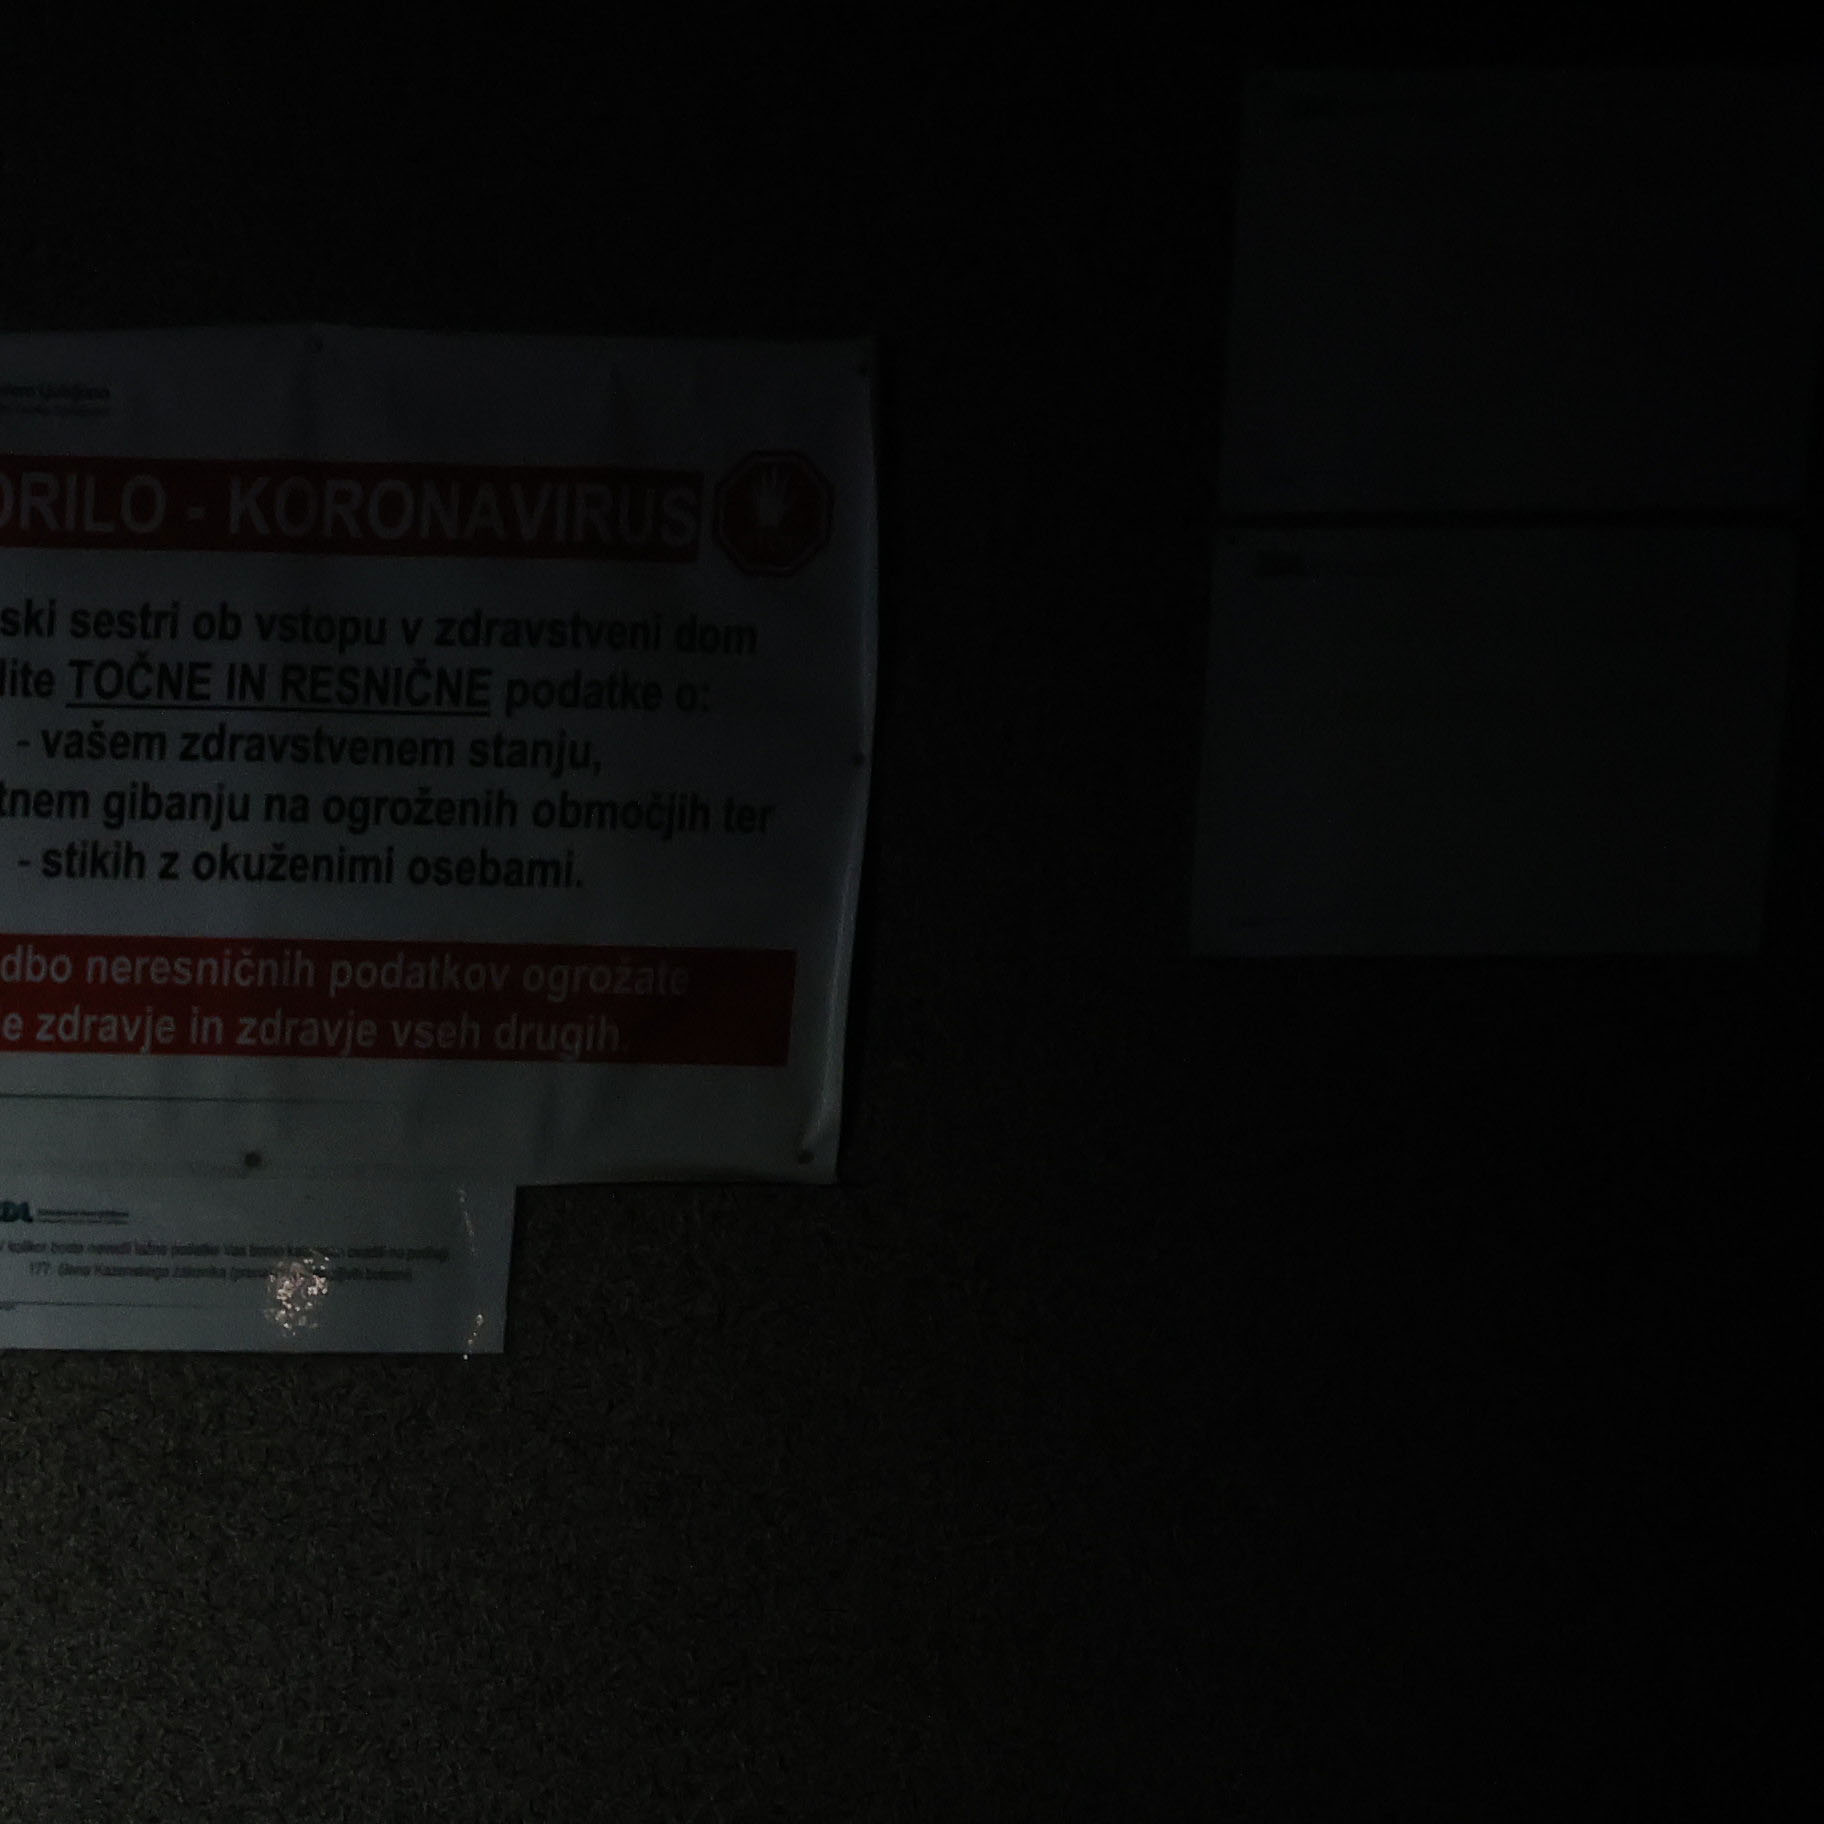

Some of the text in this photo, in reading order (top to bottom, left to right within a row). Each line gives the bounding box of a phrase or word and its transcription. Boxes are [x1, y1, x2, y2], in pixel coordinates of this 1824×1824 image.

[228, 474, 699, 549] KORONAVIRUS
[70, 601, 179, 639] sestri
[194, 603, 242, 641] ob
[256, 606, 386, 654] vstopu
[402, 620, 423, 645] v
[435, 609, 662, 652] zdravstveni
[675, 614, 758, 655] dom
[68, 650, 211, 701] TOČNE
[227, 662, 265, 702] IN
[281, 656, 493, 707] RESNIČNE
[506, 671, 662, 714] podatke
[676, 680, 711, 713] o:
[41, 721, 166, 762] vašem
[180, 723, 454, 767] zdravstvenem
[469, 731, 603, 777] stanju,
[103, 782, 249, 830] gibanju
[265, 793, 309, 823] na
[322, 786, 517, 836] ogroženih
[532, 794, 711, 841] območjih
[723, 801, 776, 834] ter
[42, 843, 145, 879] stikih
[159, 854, 179, 879] z
[193, 845, 394, 884] okuženimi
[409, 848, 584, 889] osebami.
[86, 947, 316, 988] neresničnih
[328, 952, 511, 998] podatkov
[522, 956, 690, 1002] ogrožate
[36, 1004, 175, 1055] zdravje
[190, 1006, 224, 1045] in
[236, 1008, 376, 1058] zdravje
[392, 1012, 482, 1051] vseh
[494, 1012, 630, 1062] drugih.
